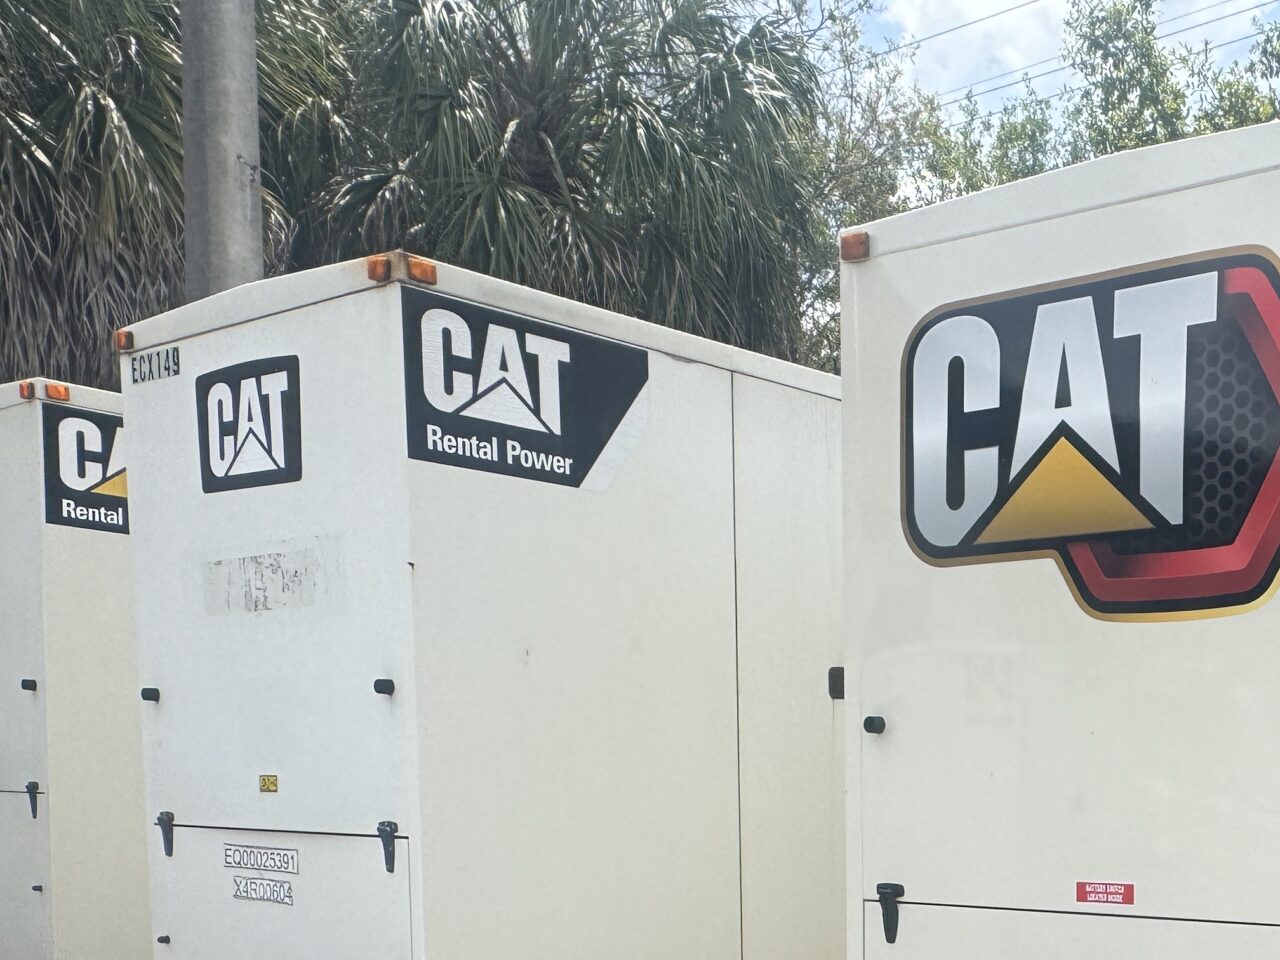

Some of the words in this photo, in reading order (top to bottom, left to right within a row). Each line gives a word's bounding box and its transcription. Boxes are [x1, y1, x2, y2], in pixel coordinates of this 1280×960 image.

[131, 347, 179, 384] ECX149
[421, 308, 571, 436] CAT
[207, 370, 288, 478] CAT
[912, 270, 1219, 547] CAT
[426, 424, 498, 462] Rental
[506, 439, 573, 475] Power
[62, 498, 123, 525] Rental
[224, 848, 295, 871] EQ00025391
